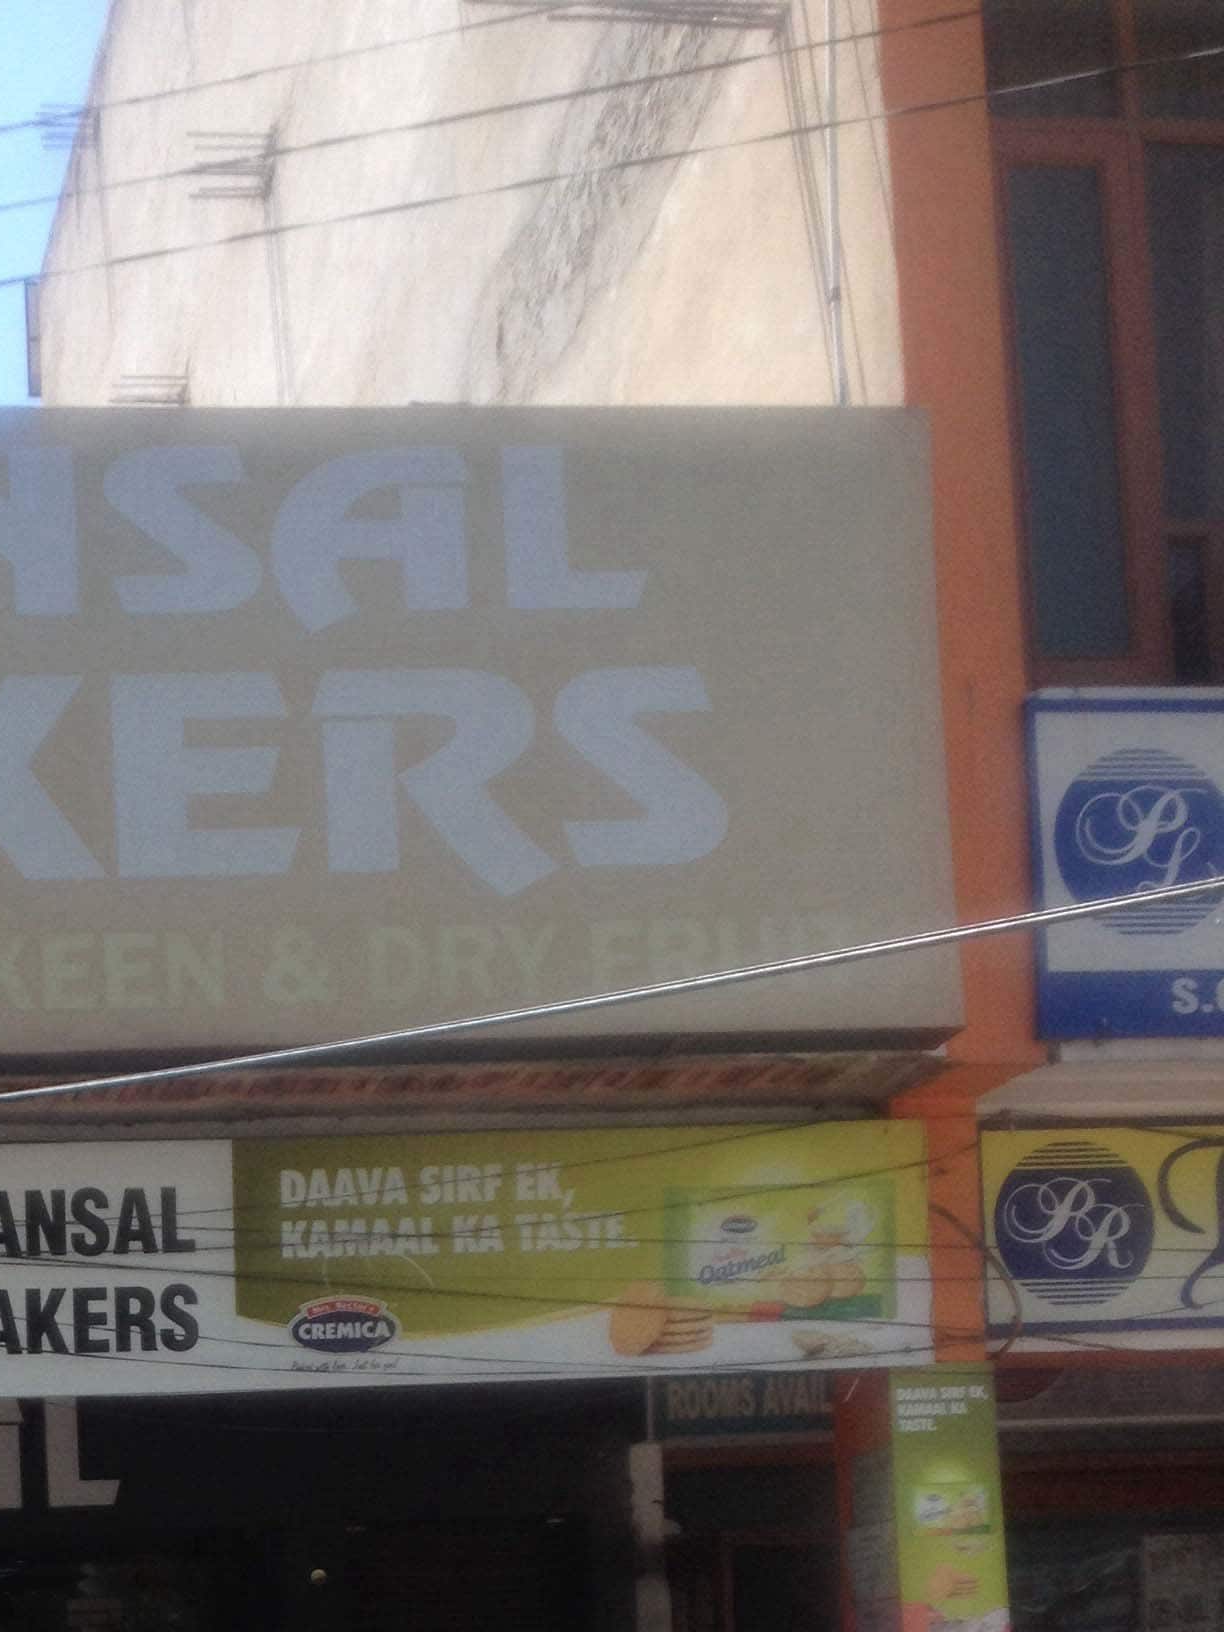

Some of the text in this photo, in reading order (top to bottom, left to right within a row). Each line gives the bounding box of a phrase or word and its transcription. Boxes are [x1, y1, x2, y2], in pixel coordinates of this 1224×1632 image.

[263, 926, 336, 1008] &
[366, 922, 558, 1005] DRY
[280, 1168, 408, 1208] DAAVA
[418, 1164, 503, 1205] SIRF
[281, 1216, 439, 1258] KAMAAL
[452, 1214, 504, 1254] KA
[697, 1245, 787, 1285] Oatmeal
[298, 1320, 391, 1340] CREMICA
